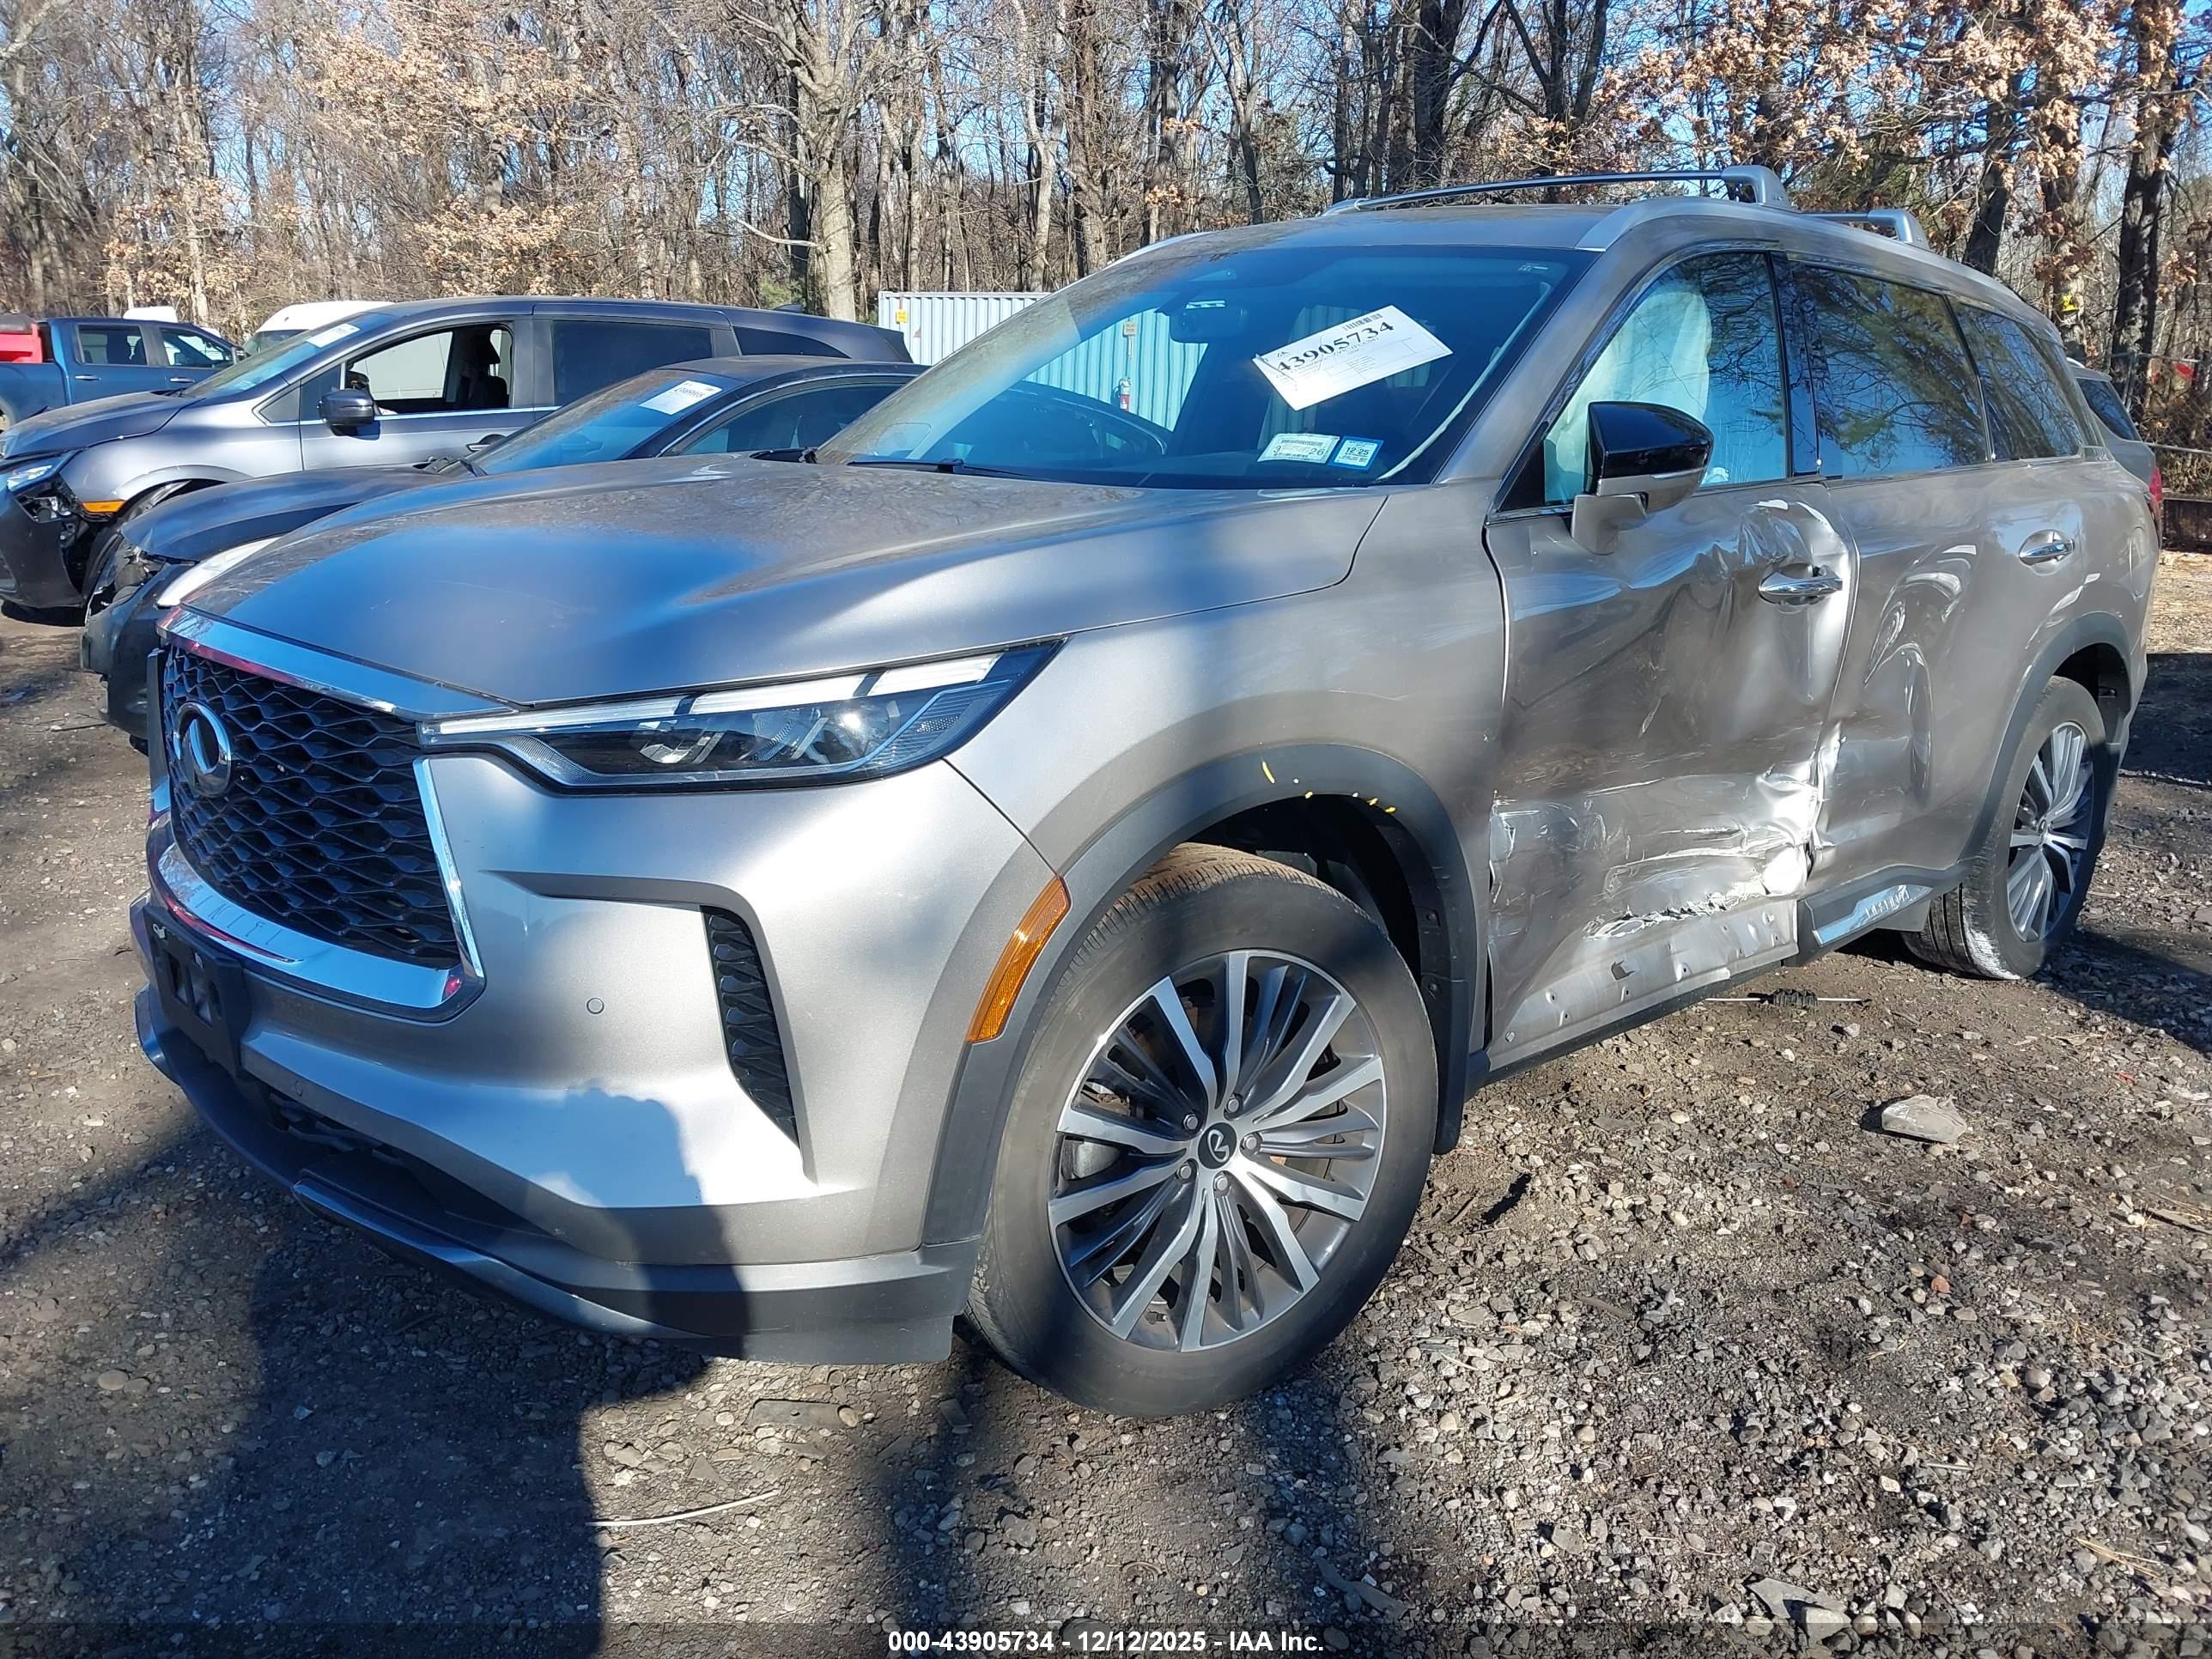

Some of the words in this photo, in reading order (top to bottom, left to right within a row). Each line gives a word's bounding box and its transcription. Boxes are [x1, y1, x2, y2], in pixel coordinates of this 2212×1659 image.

[1277, 320, 1395, 371] 43905734
[1273, 445, 1282, 454] 3
[1308, 447, 1325, 456] 26
